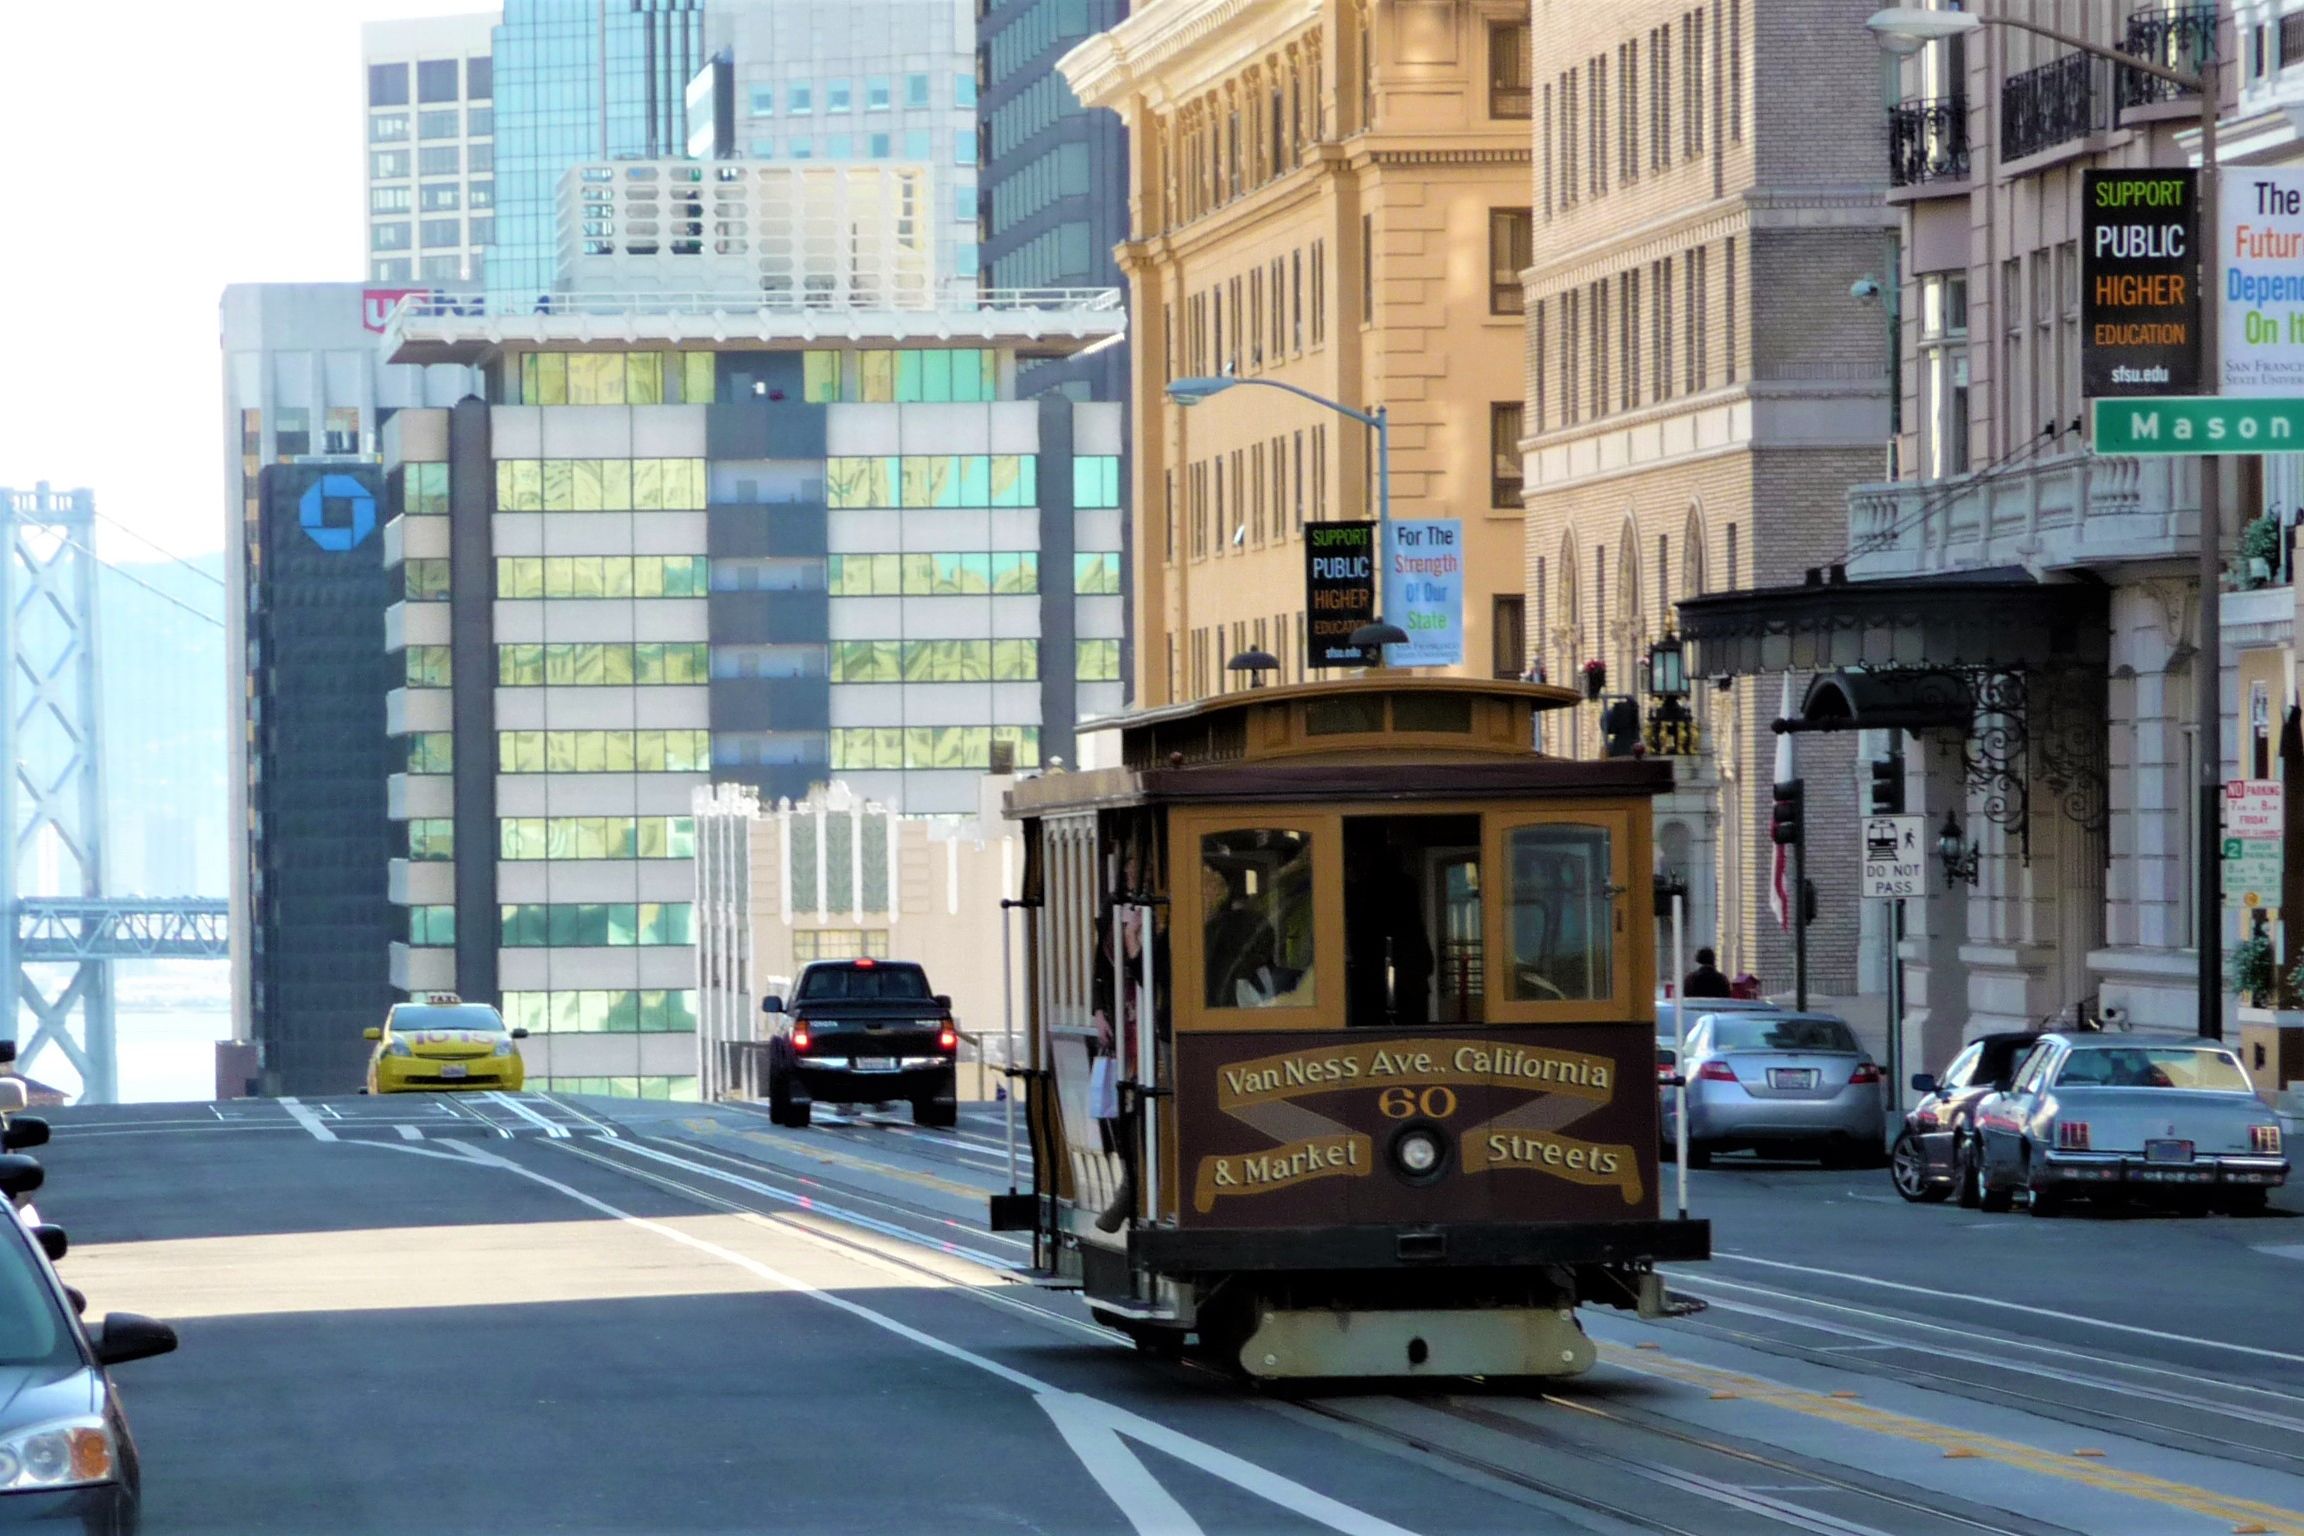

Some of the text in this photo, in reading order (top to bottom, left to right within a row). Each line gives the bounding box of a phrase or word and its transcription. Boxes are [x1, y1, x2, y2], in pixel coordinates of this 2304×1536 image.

[2095, 180, 2185, 207] SUPPORT
[2254, 182, 2301, 215] The
[2095, 224, 2185, 258] PUBLIC
[2095, 274, 2186, 306] HIGHER
[2095, 324, 2186, 345] EDUCATION
[2246, 311, 2278, 345] On
[2111, 365, 2170, 384] sfsu.edu
[2131, 412, 2291, 440] Mason
[1312, 528, 1368, 546] SUPPORT
[1397, 526, 1454, 546] For The
[1313, 556, 1369, 579] PUBLIC
[1395, 554, 1457, 577] Strength
[1314, 588, 1369, 609] HIGHER
[1406, 582, 1448, 602] Of Our
[1408, 611, 1448, 630] State
[2246, 785, 2280, 796] PARKING
[2239, 815, 2269, 825] FRIDAY
[2228, 842, 2238, 857] 2
[1867, 864, 1920, 877] DO NOT
[1876, 881, 1912, 894] PASS
[1226, 1067, 1279, 1095] Van
[1284, 1056, 1359, 1086] Ness
[1454, 1047, 1609, 1088] California
[1378, 1086, 1457, 1119] 60
[1214, 1139, 1358, 1186] & Market
[1488, 1135, 1619, 1173] Streets
